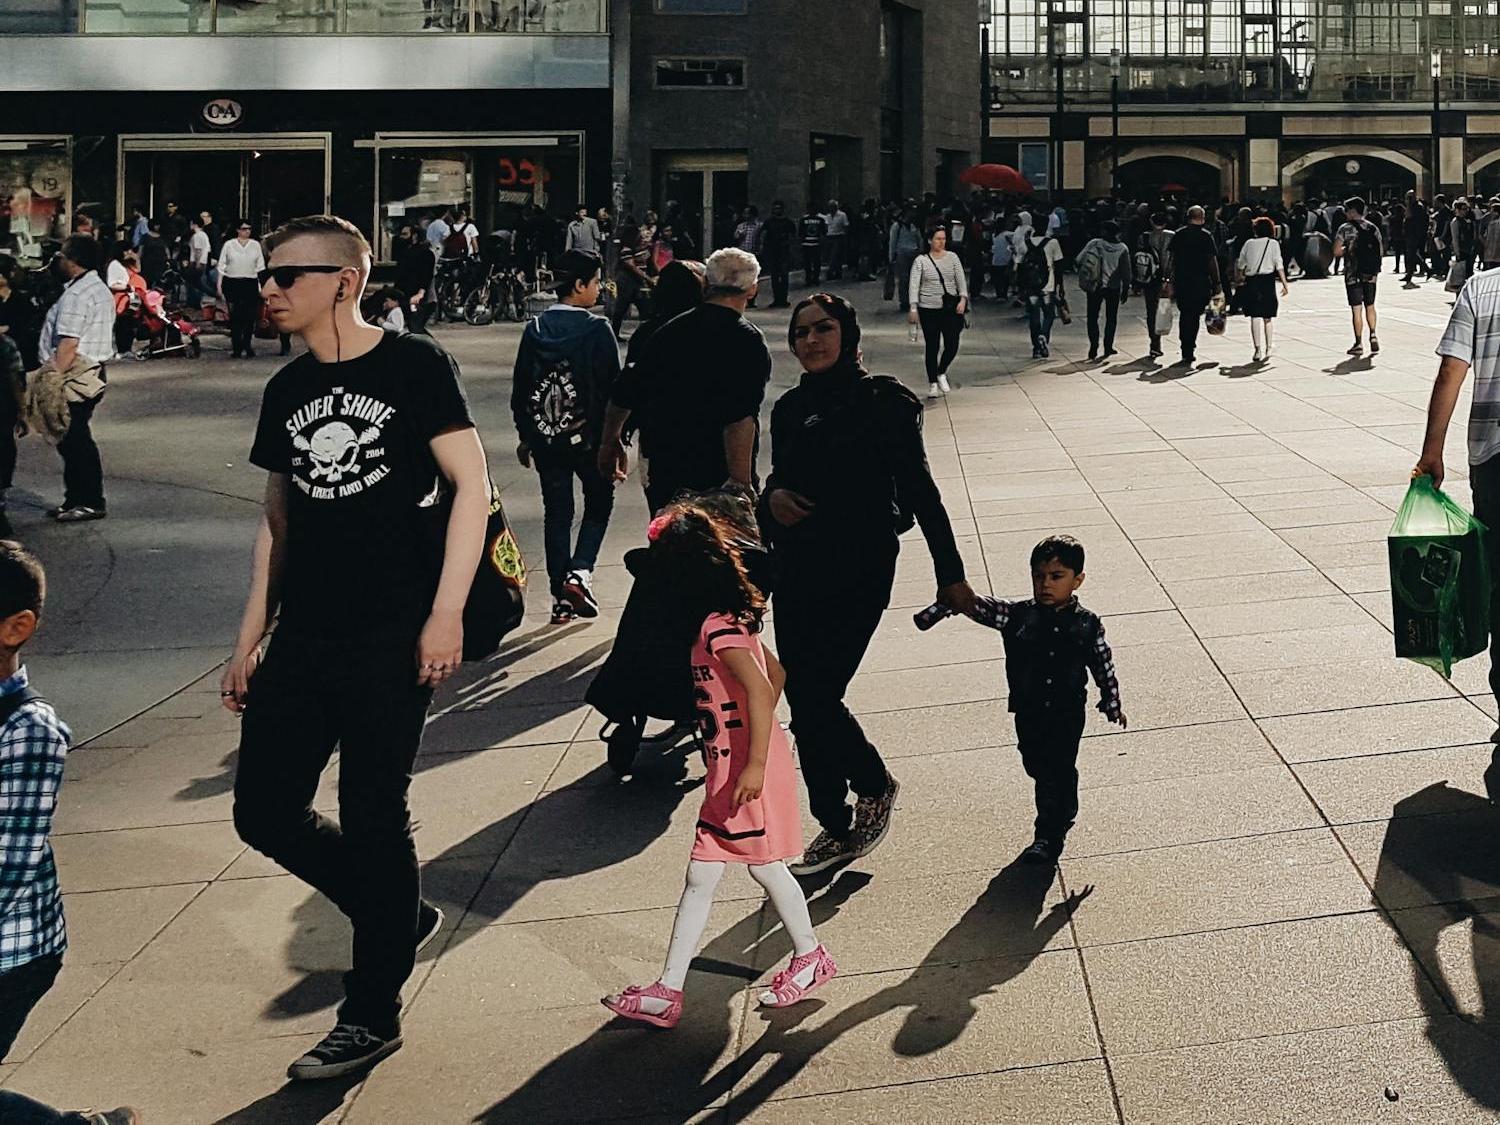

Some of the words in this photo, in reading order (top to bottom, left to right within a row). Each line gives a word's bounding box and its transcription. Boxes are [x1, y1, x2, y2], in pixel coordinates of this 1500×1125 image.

[207, 103, 237, 119] C&A
[285, 395, 335, 438] SILVER
[340, 392, 397, 429] SHINE
[338, 479, 364, 498] AND
[363, 463, 392, 488] ROLL
